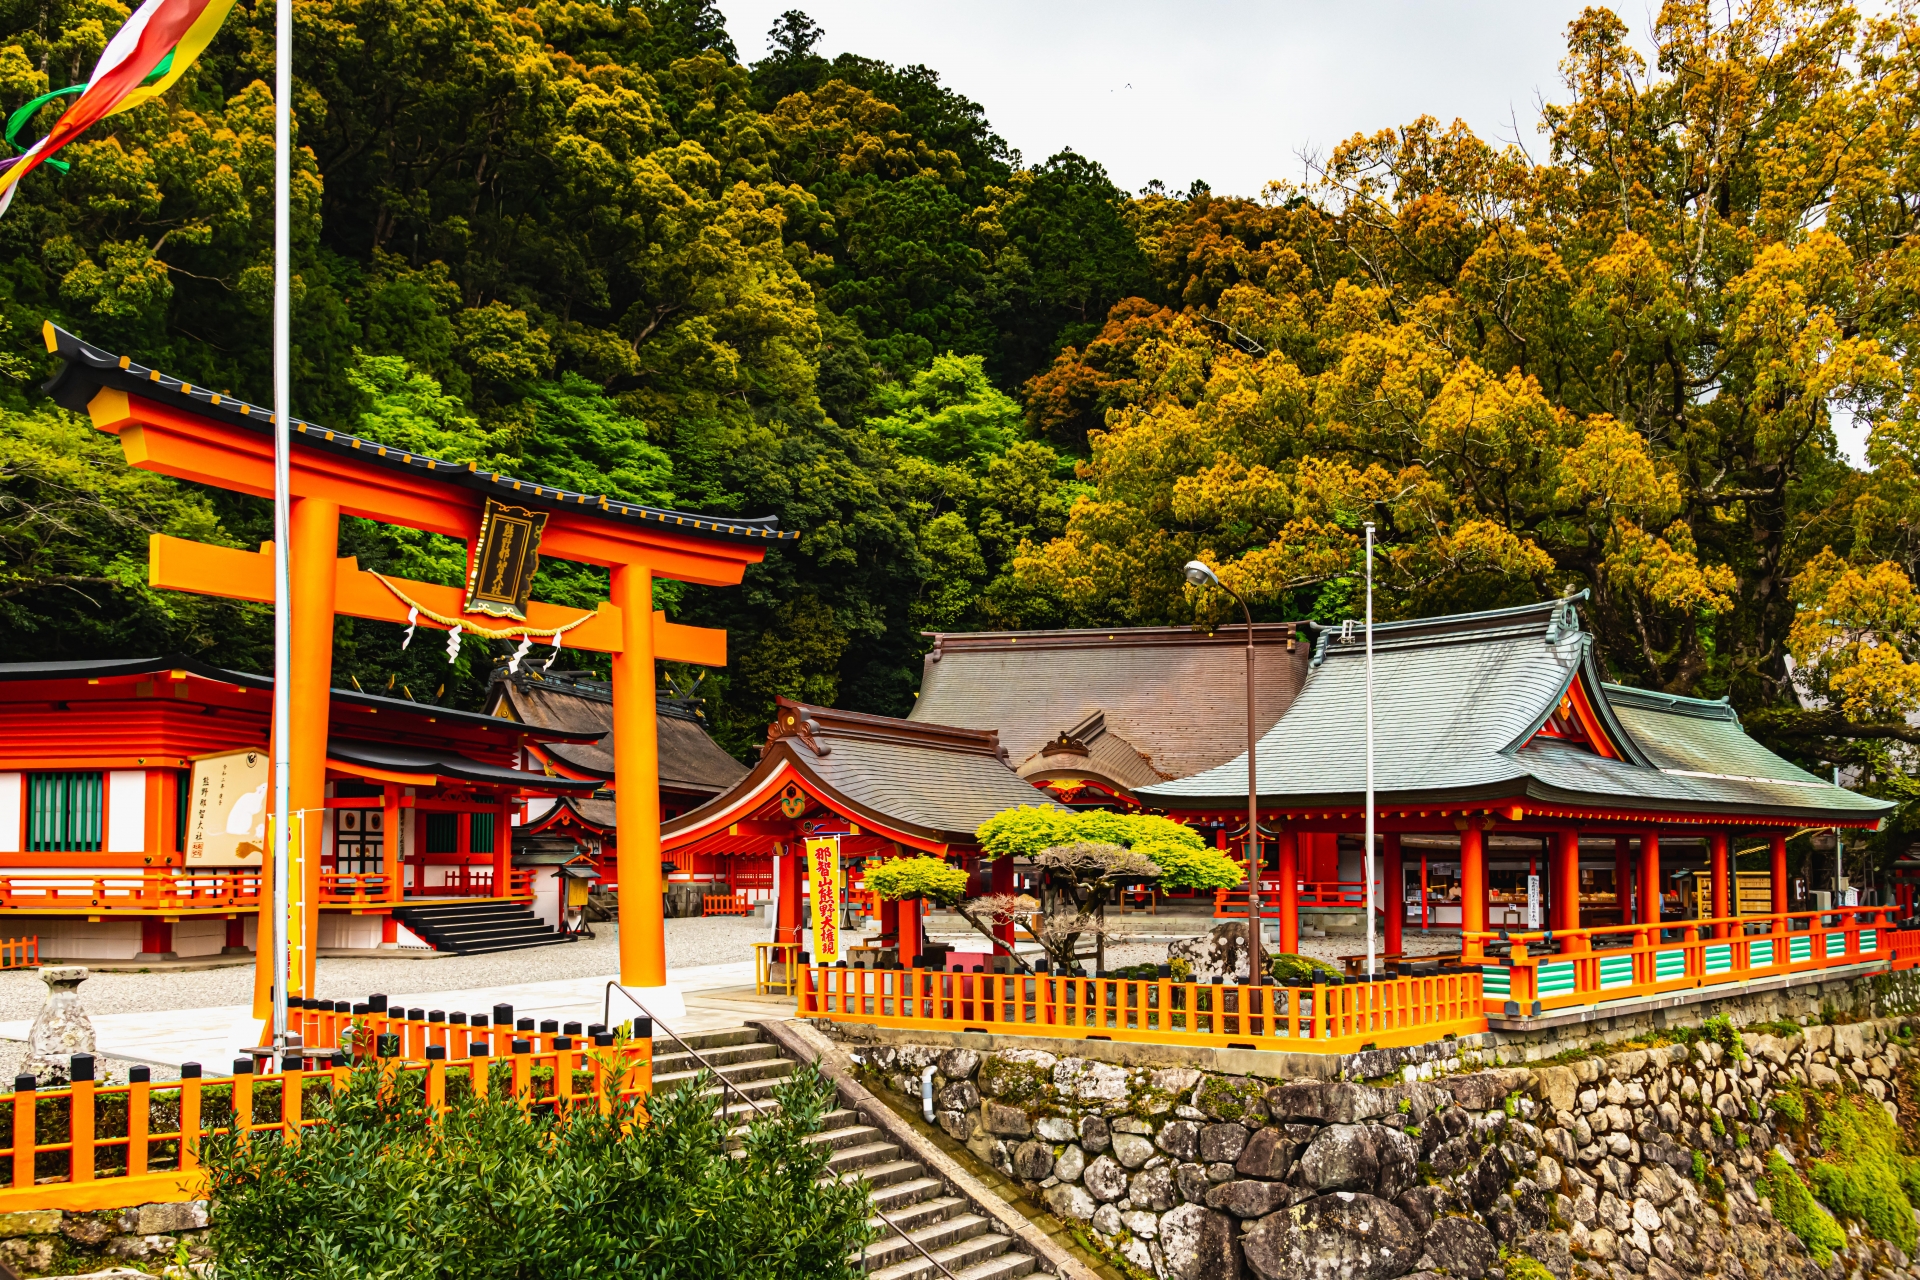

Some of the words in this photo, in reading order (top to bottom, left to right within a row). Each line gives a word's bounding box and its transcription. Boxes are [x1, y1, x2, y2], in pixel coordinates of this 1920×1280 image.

[491, 523, 515, 595] 熊野那智大社
[195, 776, 210, 841] 熊野那智大社
[220, 764, 228, 789] 令和二年
[814, 846, 836, 955] 那智山熊野大権現
